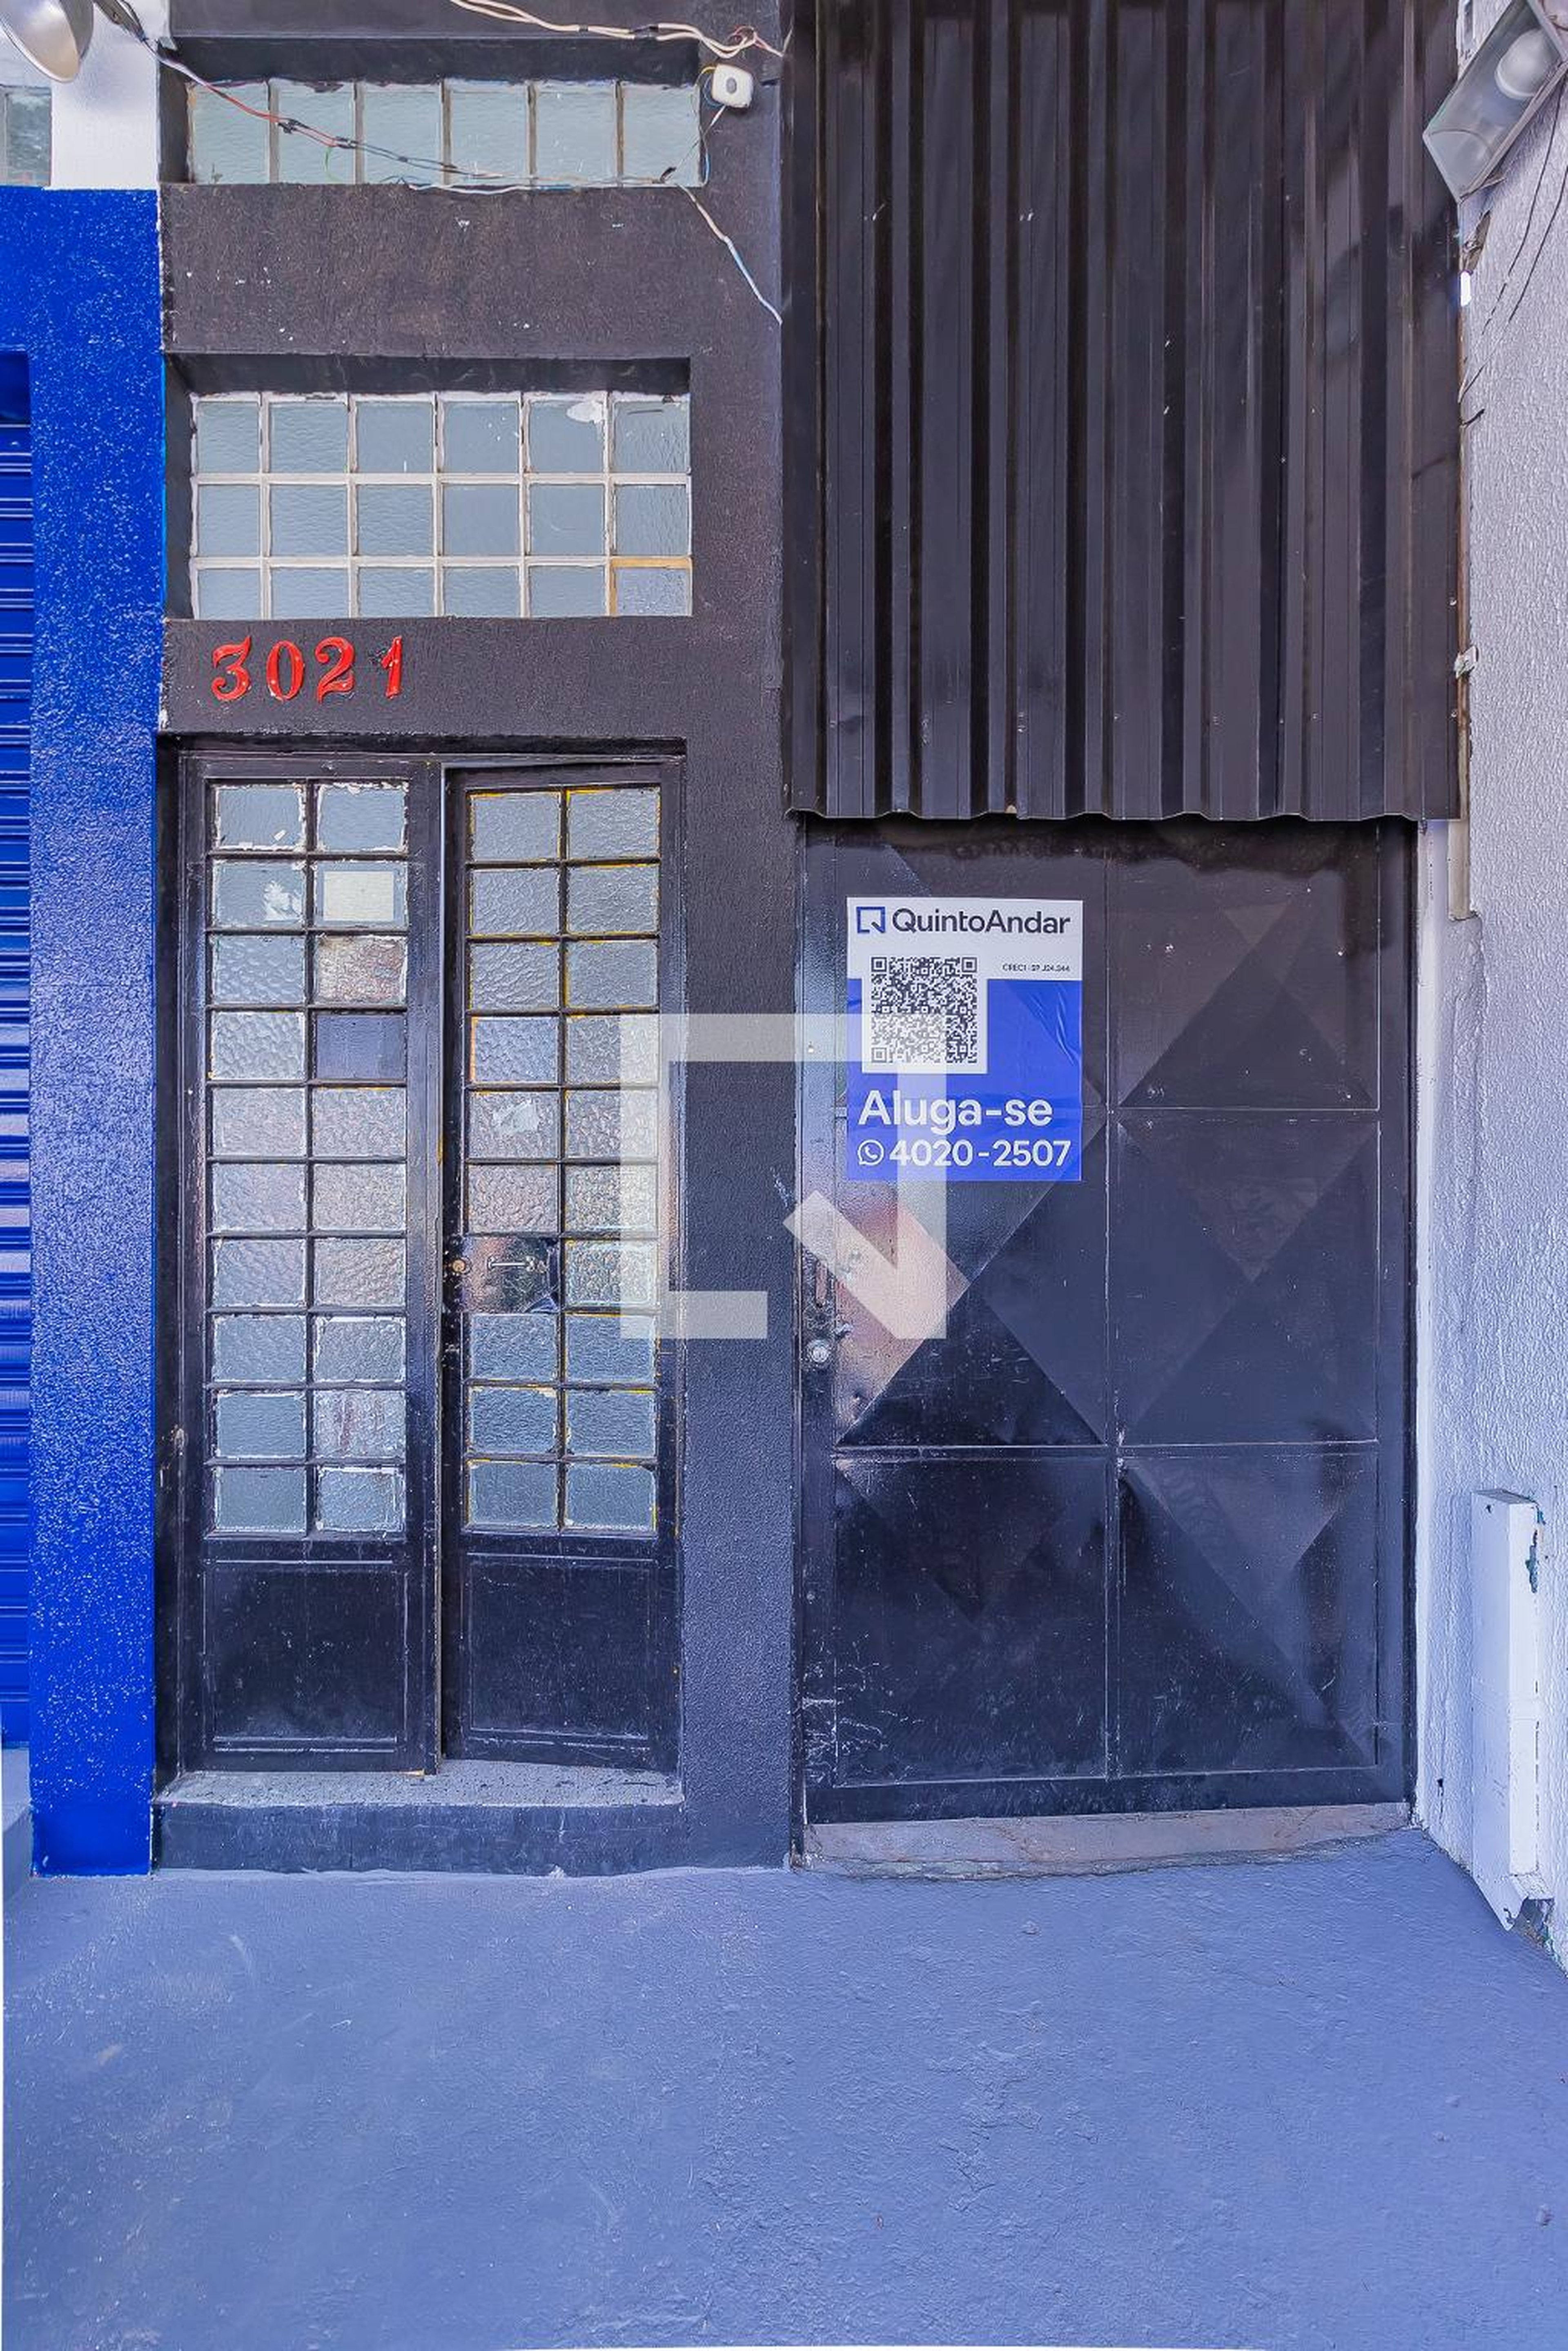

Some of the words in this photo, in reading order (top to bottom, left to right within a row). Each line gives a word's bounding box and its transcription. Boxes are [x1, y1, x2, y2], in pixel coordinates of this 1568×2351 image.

[212, 636, 402, 703] 3021
[892, 908, 1071, 933] QuintoAndar
[858, 1090, 1053, 1135] Aluga-se
[889, 1140, 1071, 1166] 4020-2507
